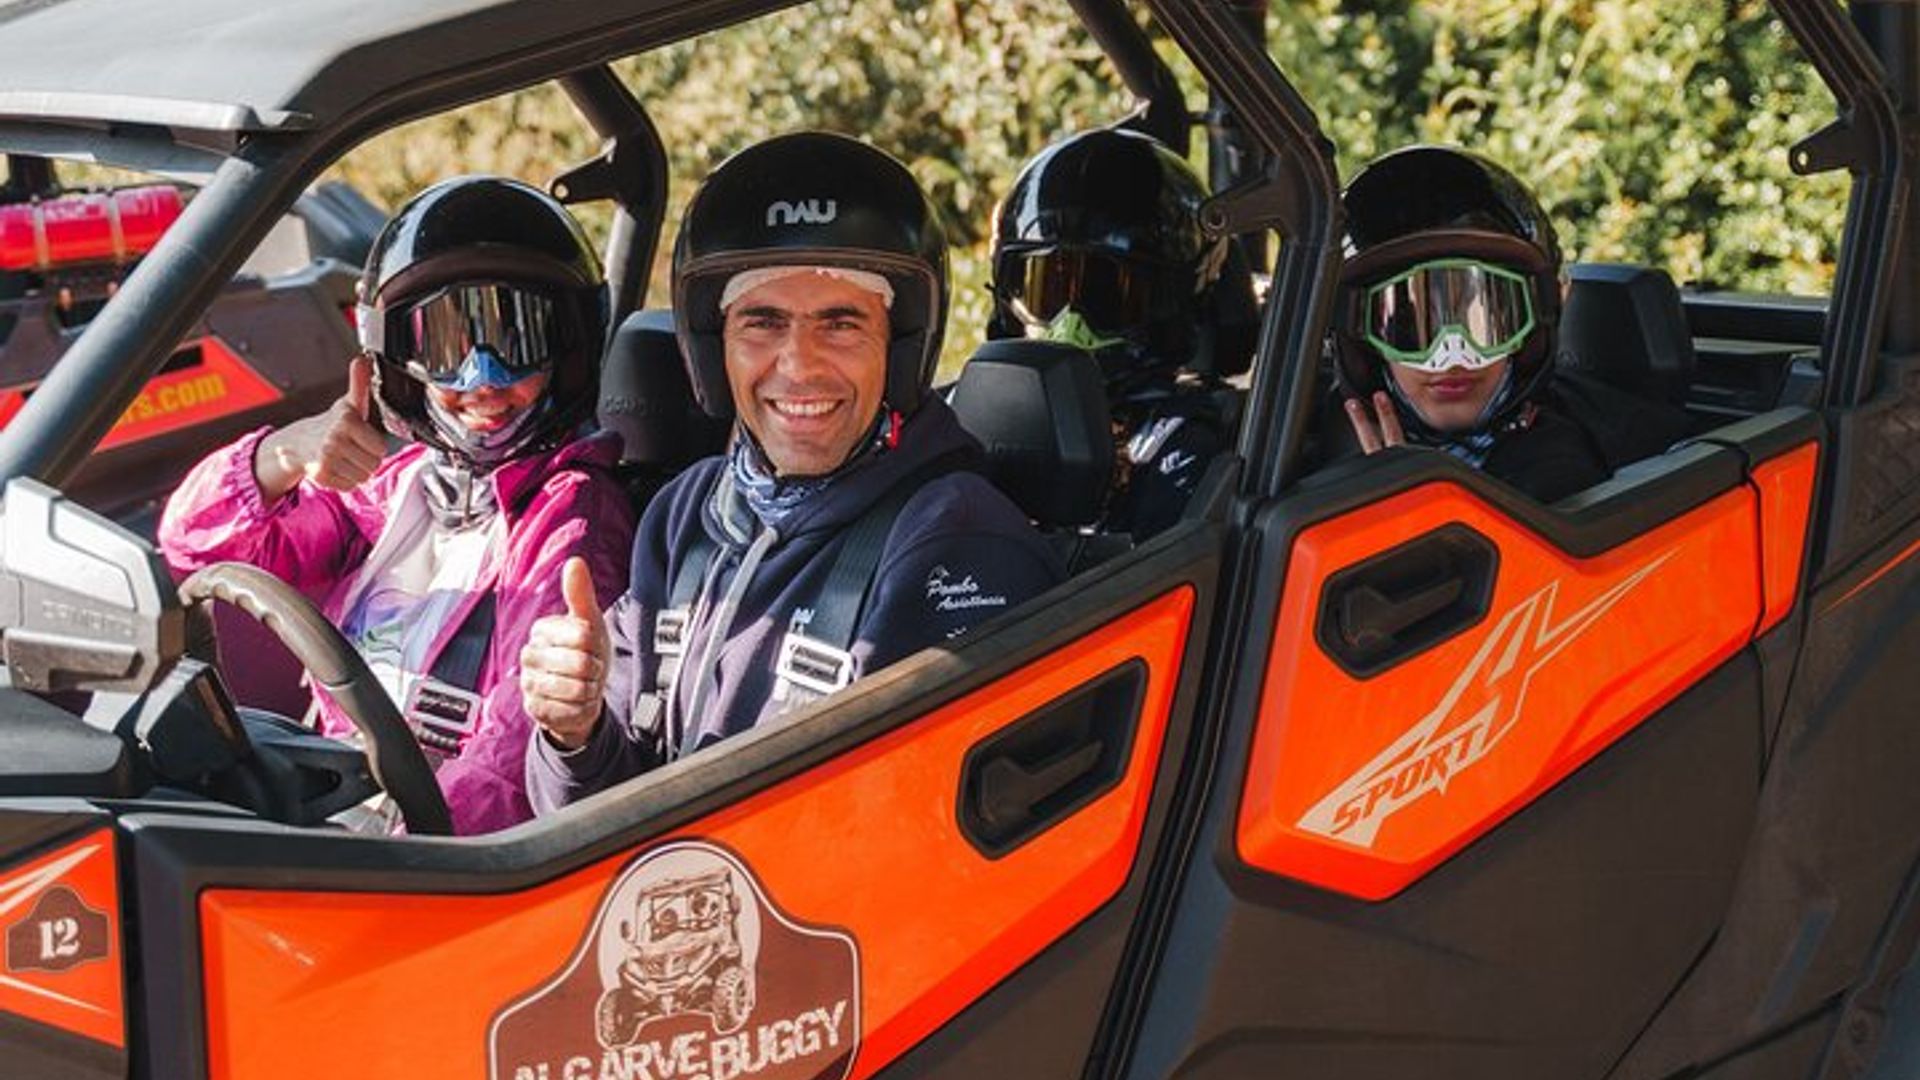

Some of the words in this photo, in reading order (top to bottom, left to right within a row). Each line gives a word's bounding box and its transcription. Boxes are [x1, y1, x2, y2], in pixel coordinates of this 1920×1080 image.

[1331, 722, 1484, 835] SPORT
[39, 918, 80, 960] 12
[711, 1001, 846, 1080] BUGGY
